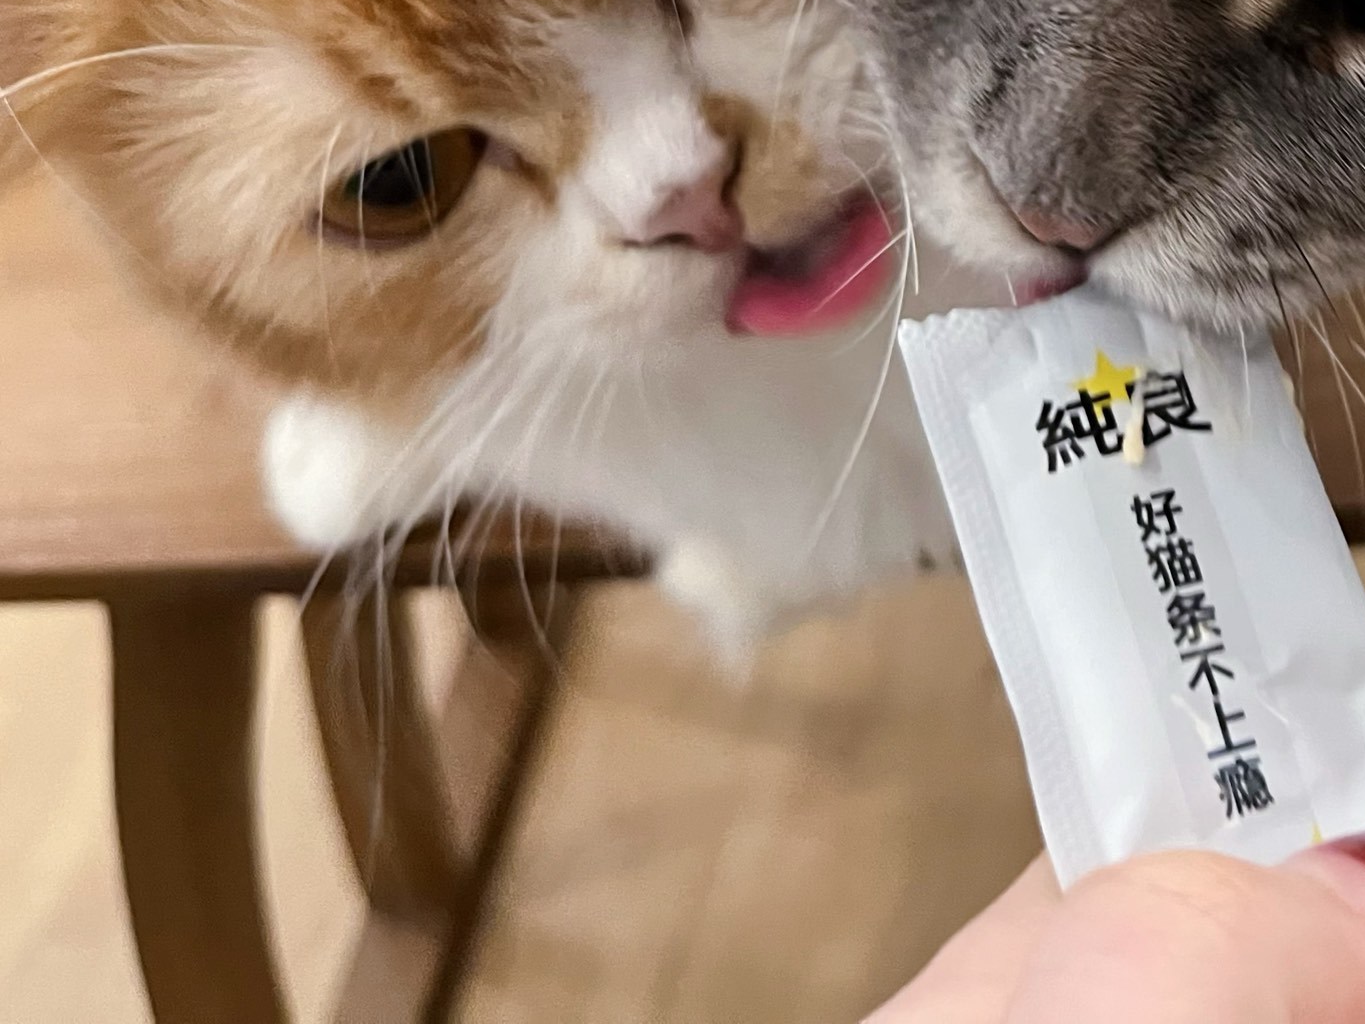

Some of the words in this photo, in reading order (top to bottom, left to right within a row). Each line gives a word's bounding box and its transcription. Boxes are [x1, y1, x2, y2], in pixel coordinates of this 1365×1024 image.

[1036, 370, 1212, 472] 純良
[1130, 488, 1274, 818] 好猫条不上瘾
